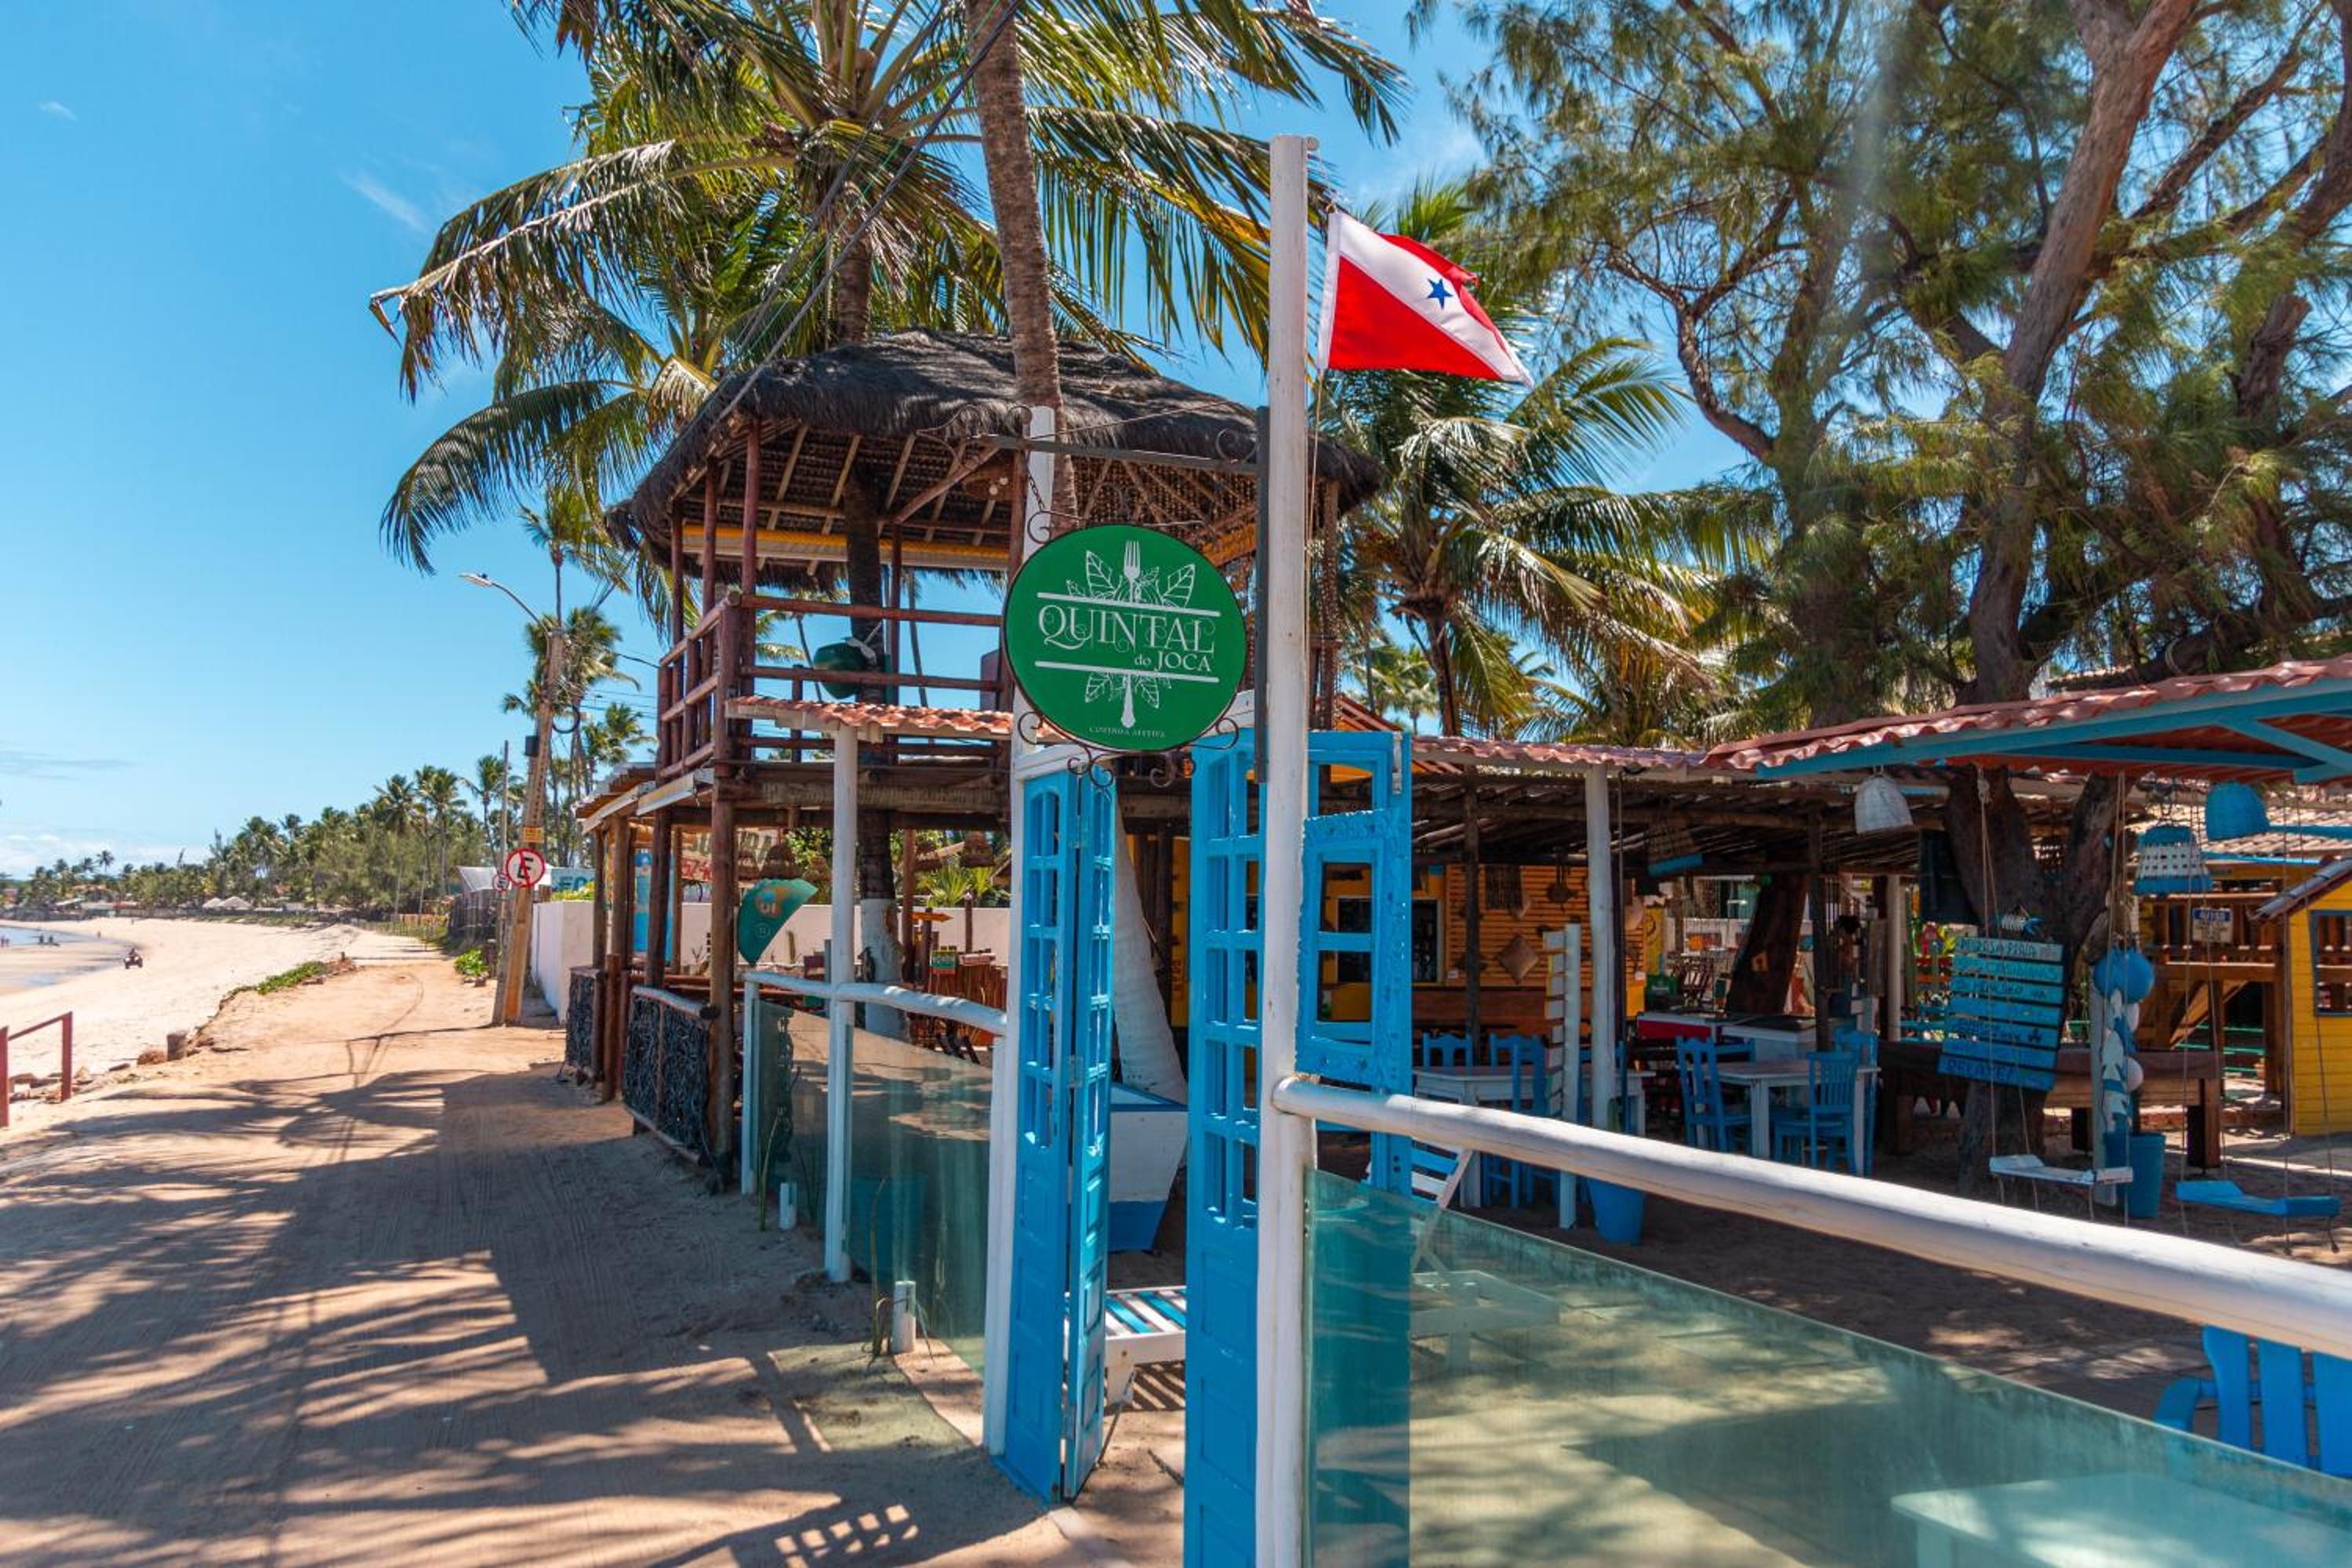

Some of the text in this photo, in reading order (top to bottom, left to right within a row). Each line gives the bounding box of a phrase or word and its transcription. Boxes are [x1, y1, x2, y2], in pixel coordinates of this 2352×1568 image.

[1039, 604, 1214, 654] QUINTAL
[1154, 651, 1211, 672] JOCA
[517, 857, 534, 880] E
